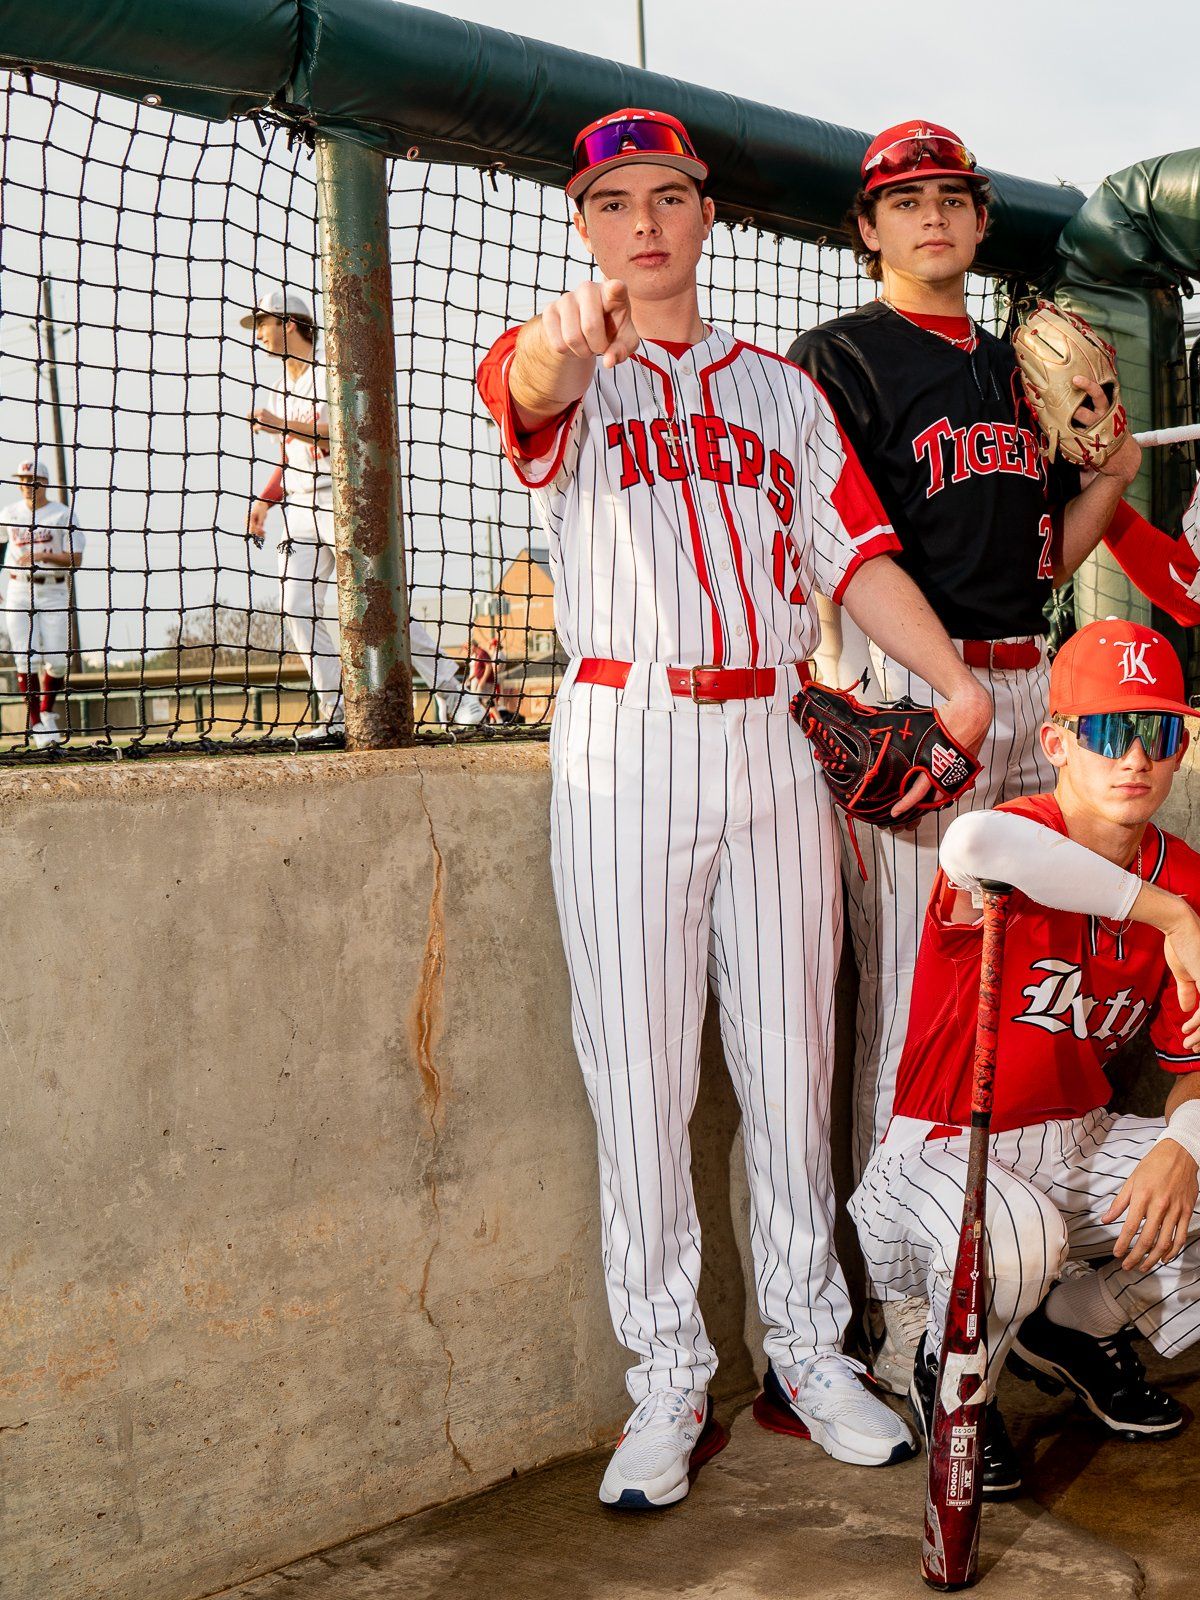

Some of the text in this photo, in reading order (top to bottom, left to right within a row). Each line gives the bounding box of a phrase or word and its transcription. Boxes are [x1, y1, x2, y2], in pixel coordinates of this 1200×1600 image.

[912, 416, 1048, 499] TIGER
[1113, 641, 1157, 685] K
[949, 1460, 959, 1498] VOODOO
